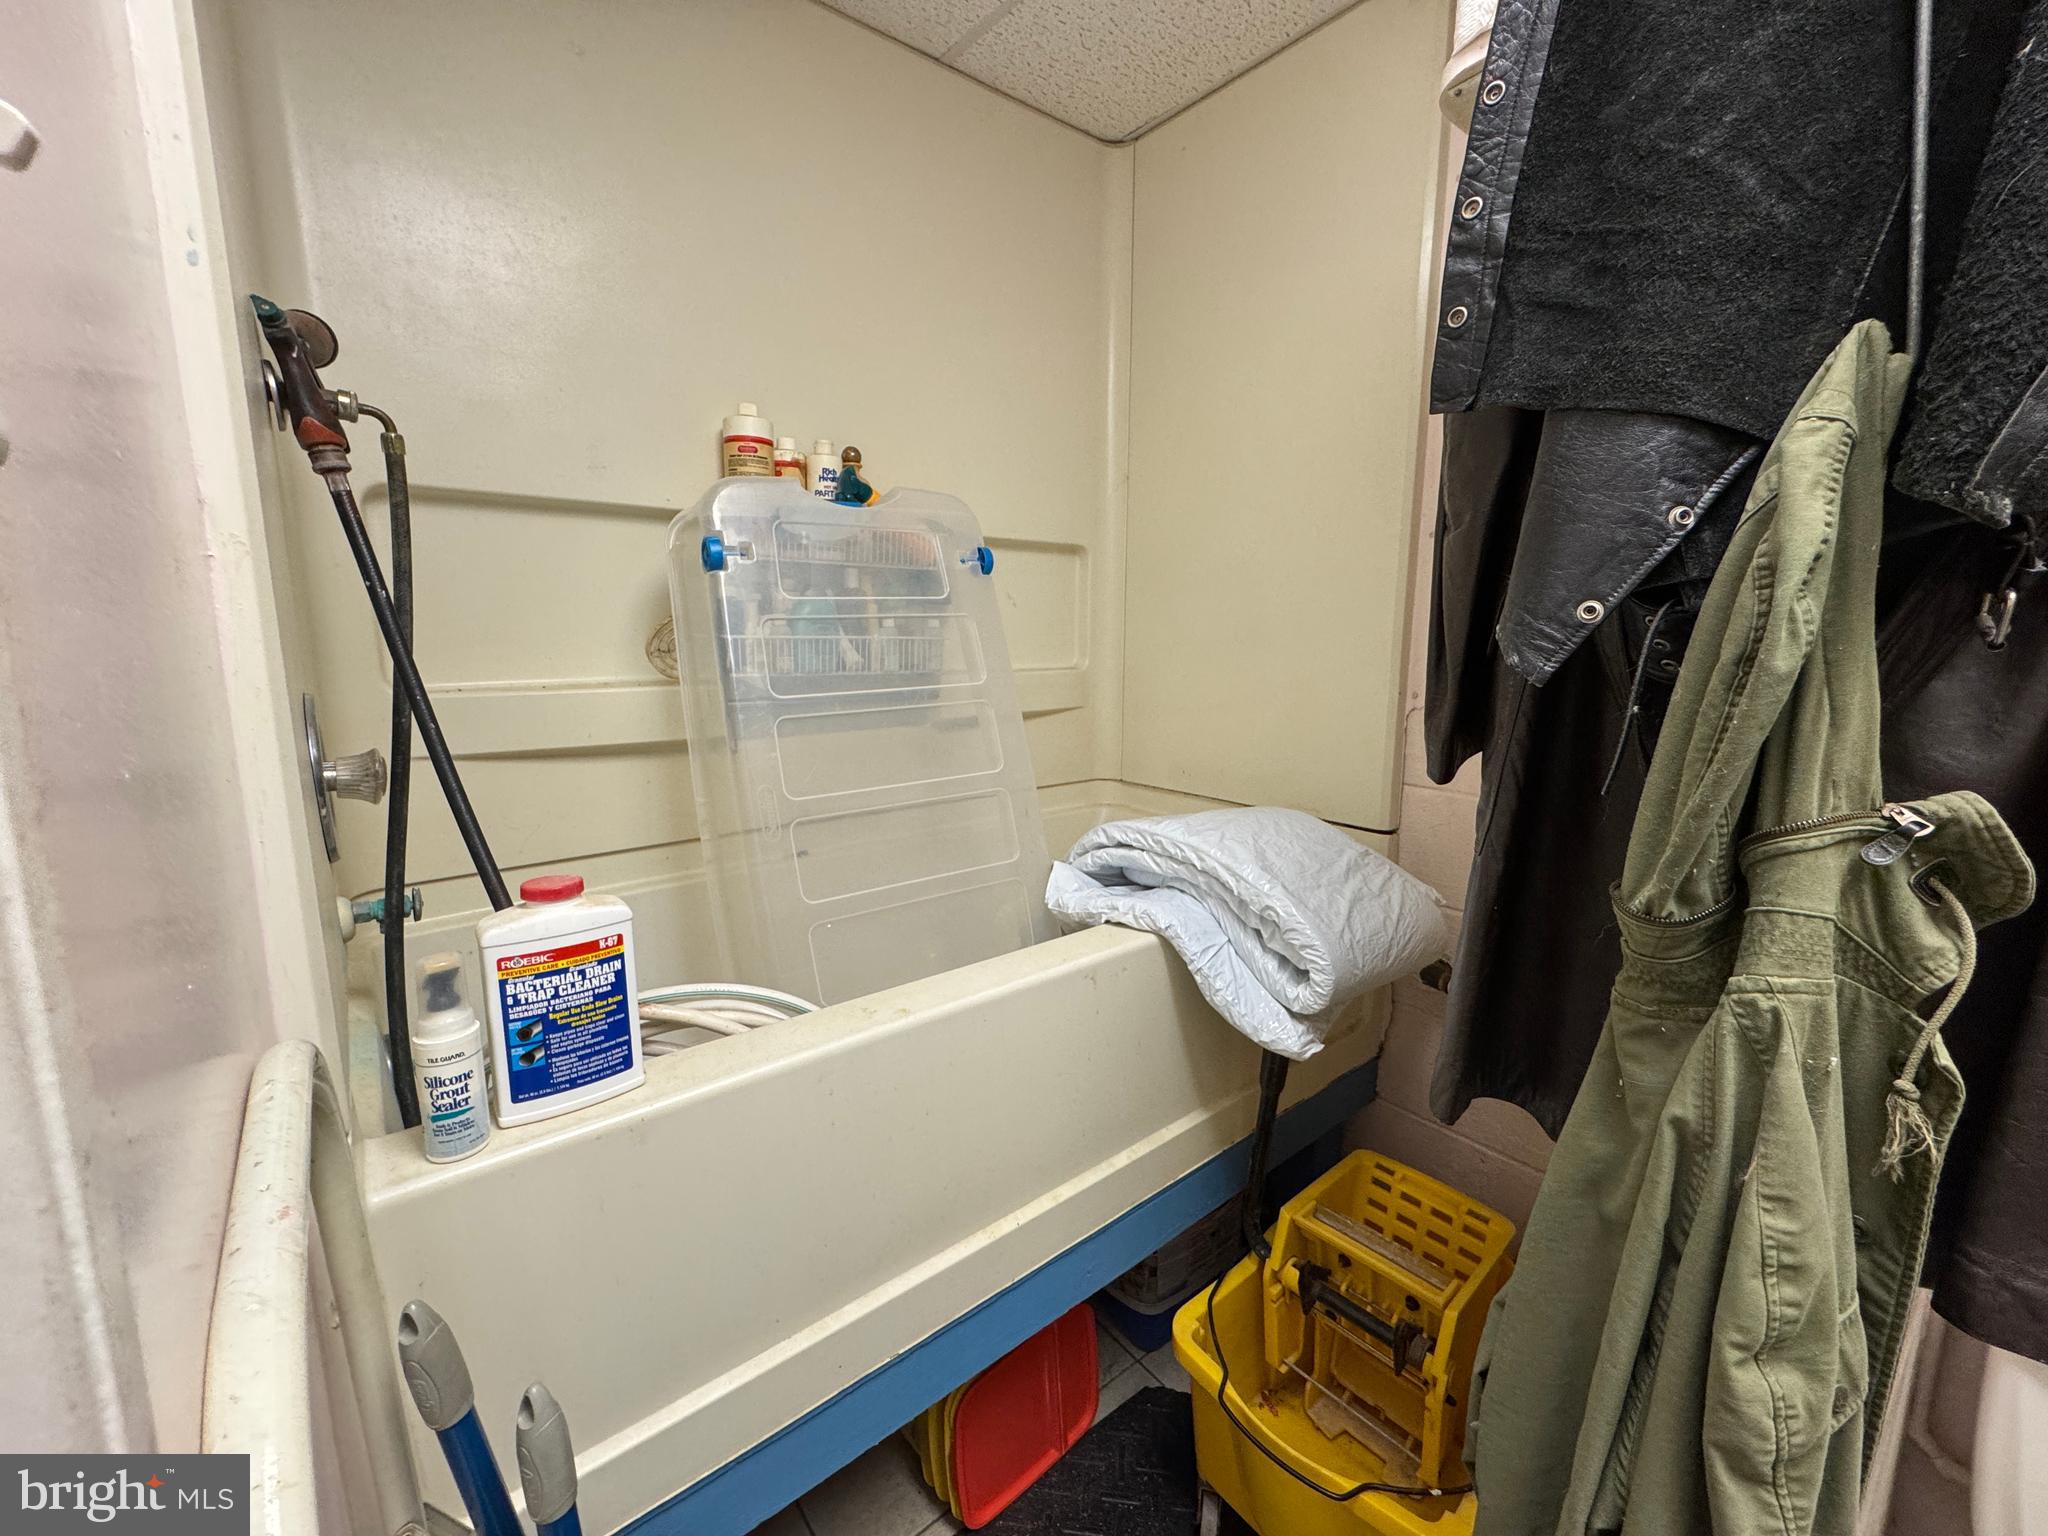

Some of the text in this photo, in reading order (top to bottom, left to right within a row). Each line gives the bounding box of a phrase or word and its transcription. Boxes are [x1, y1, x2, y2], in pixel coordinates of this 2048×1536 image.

[822, 467, 837, 476] Rich
[598, 935, 618, 949] K-67
[501, 953, 553, 969] ROEBIC
[501, 967, 540, 977] PREVENTIVE
[566, 956, 589, 965] CUIDADO
[506, 959, 621, 995] BACTERIAL DRAIN
[507, 972, 615, 1005] & TRAP CLEANER
[509, 1001, 548, 1015] LIMPIADOR
[550, 990, 593, 1005] BACTERIANO
[555, 996, 593, 1010] CISTERNAS
[423, 1069, 473, 1089] Silicone
[430, 1082, 470, 1101] Grout
[431, 1096, 471, 1114] Sealer
